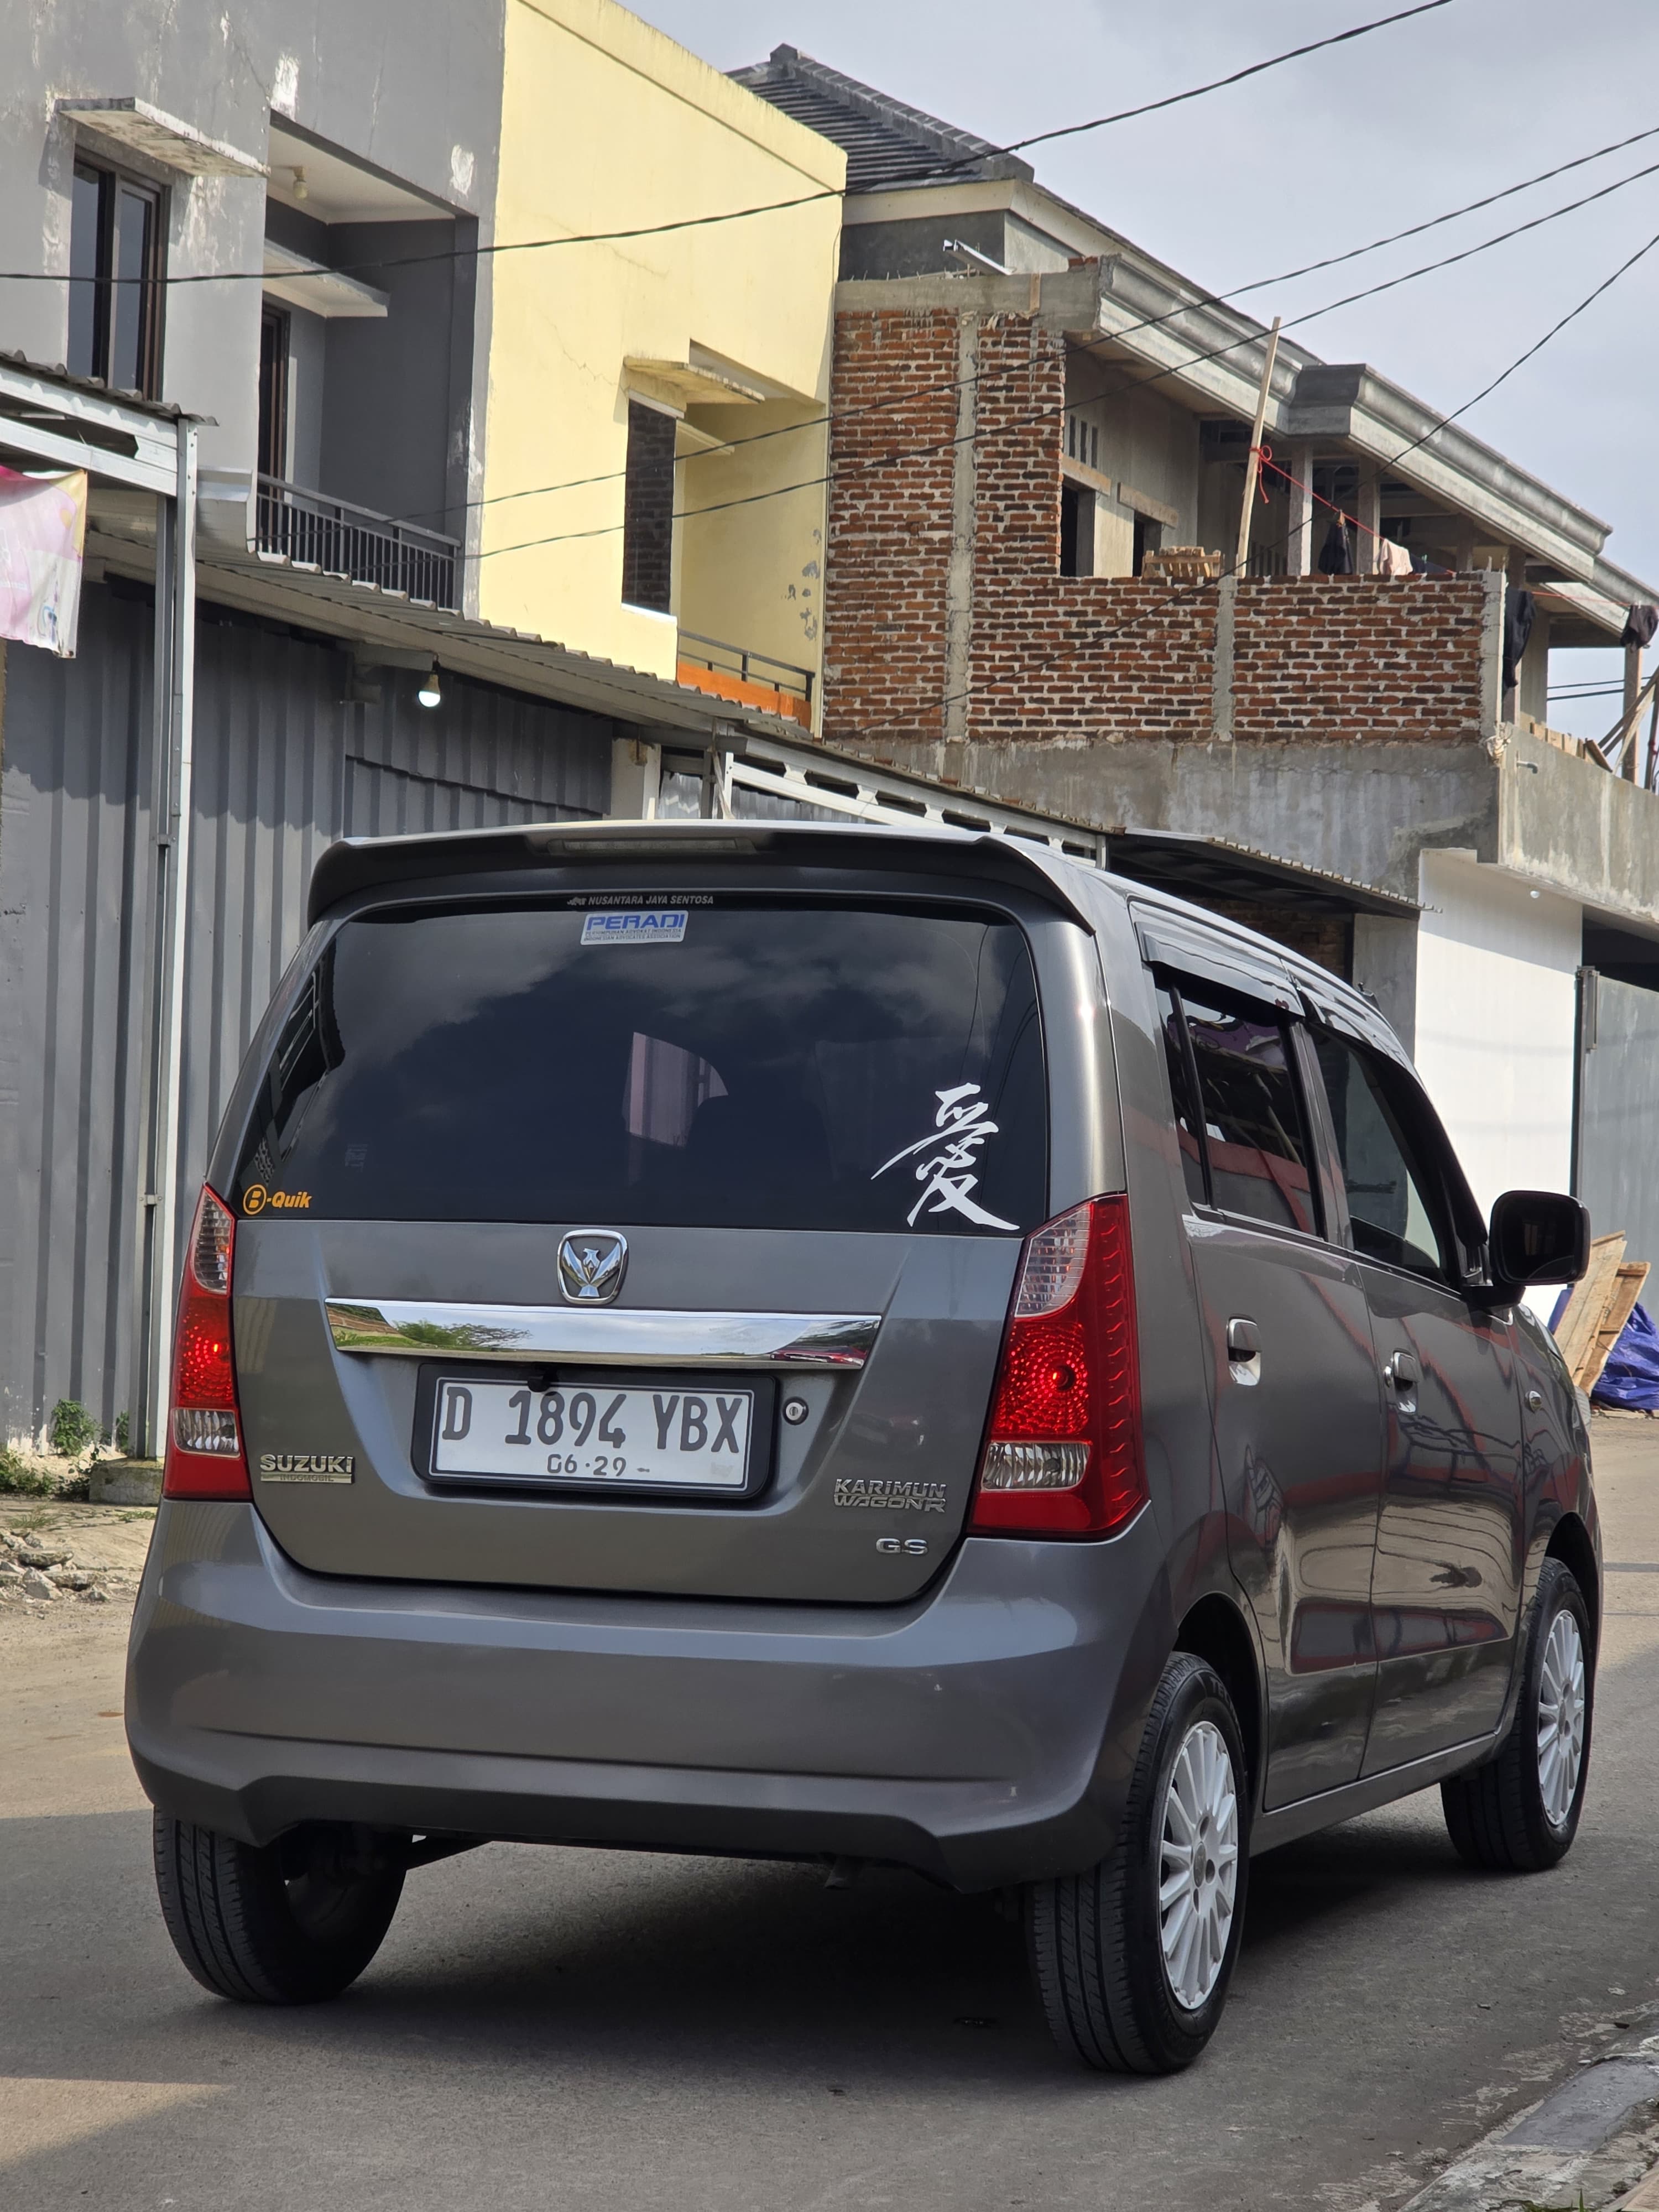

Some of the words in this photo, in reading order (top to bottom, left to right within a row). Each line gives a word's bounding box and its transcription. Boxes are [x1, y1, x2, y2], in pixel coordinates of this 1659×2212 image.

[588, 896, 643, 905] NUSANTARA
[645, 896, 667, 904] JAYA
[670, 895, 714, 904] SENTOSA
[587, 914, 685, 930] PERADI
[442, 1386, 473, 1440] D
[504, 1390, 627, 1448] 1894
[653, 1394, 743, 1454] YBX
[260, 1454, 353, 1473] SUZUKI
[834, 1478, 946, 1498] KARIMUN
[876, 1538, 928, 1554] GS
